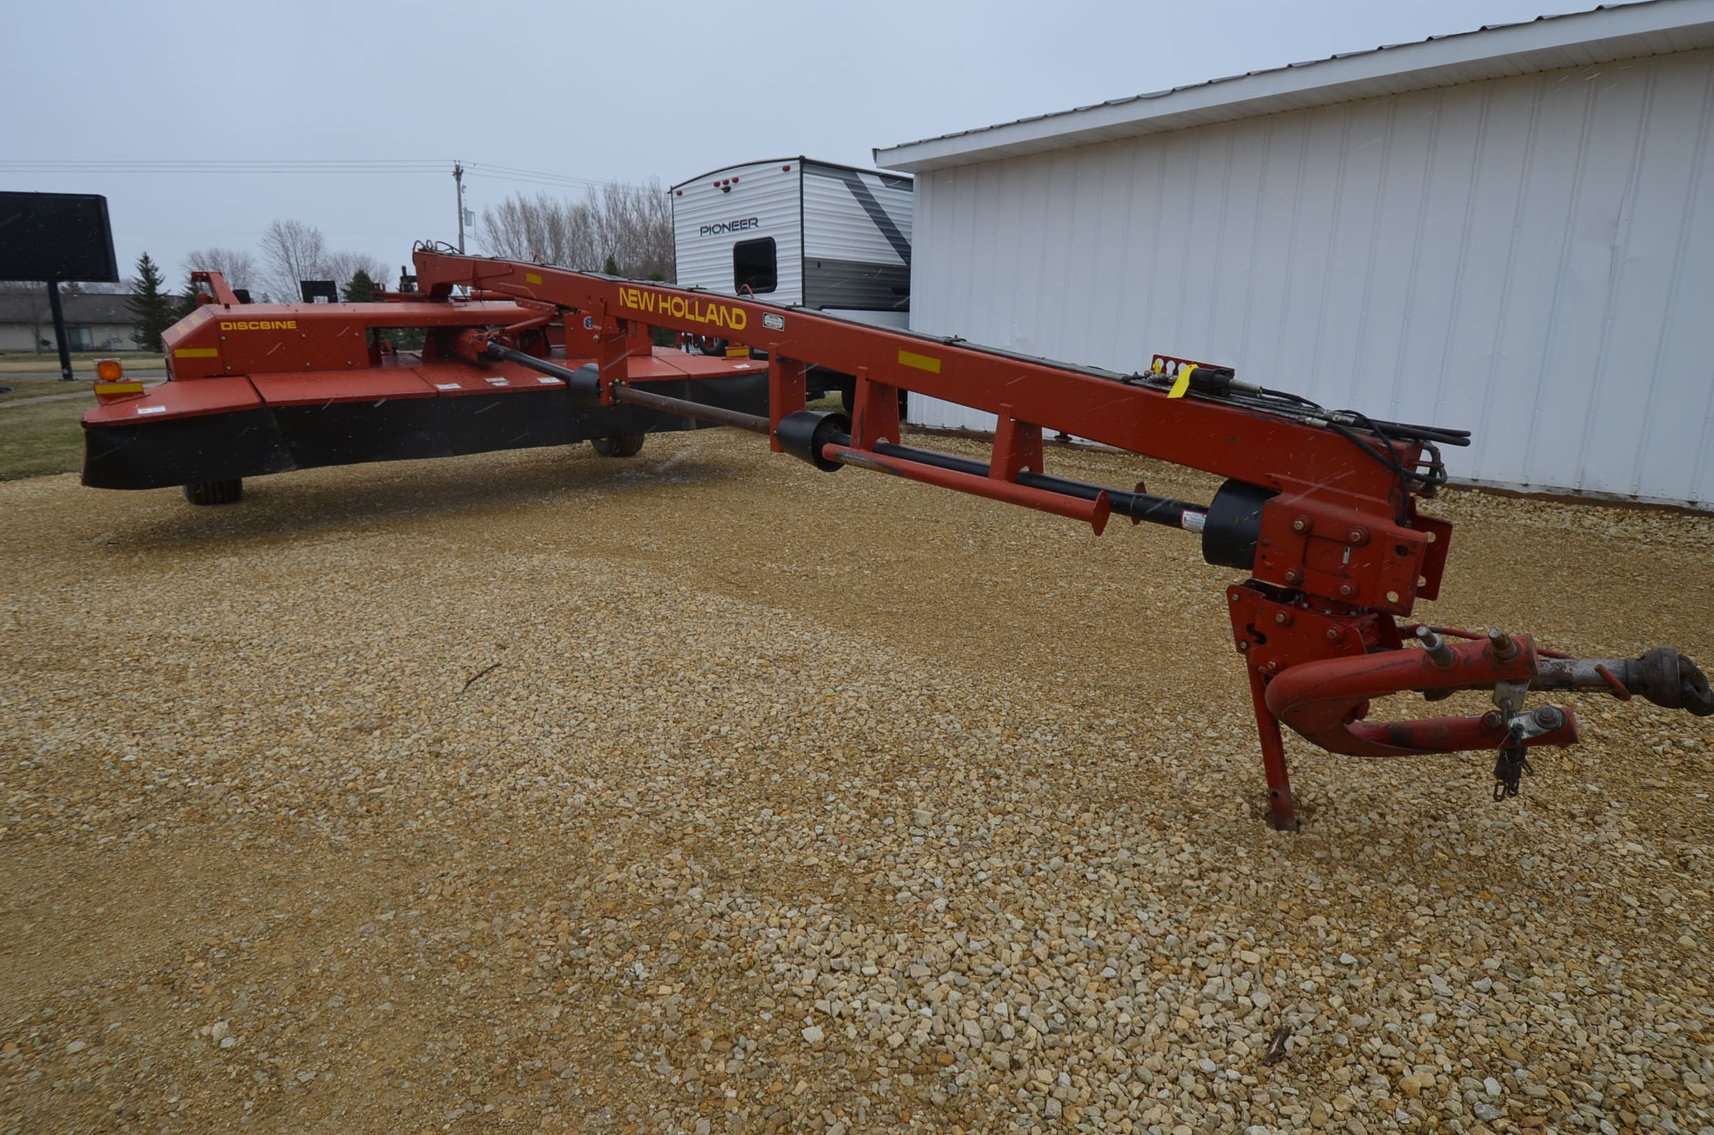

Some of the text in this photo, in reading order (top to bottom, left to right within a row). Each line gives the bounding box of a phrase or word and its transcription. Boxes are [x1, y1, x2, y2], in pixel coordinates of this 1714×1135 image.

[700, 217, 759, 237] PIONEER
[619, 287, 655, 313] NEW
[658, 294, 747, 330] HOLLAND
[220, 320, 297, 331] DISCBINE
